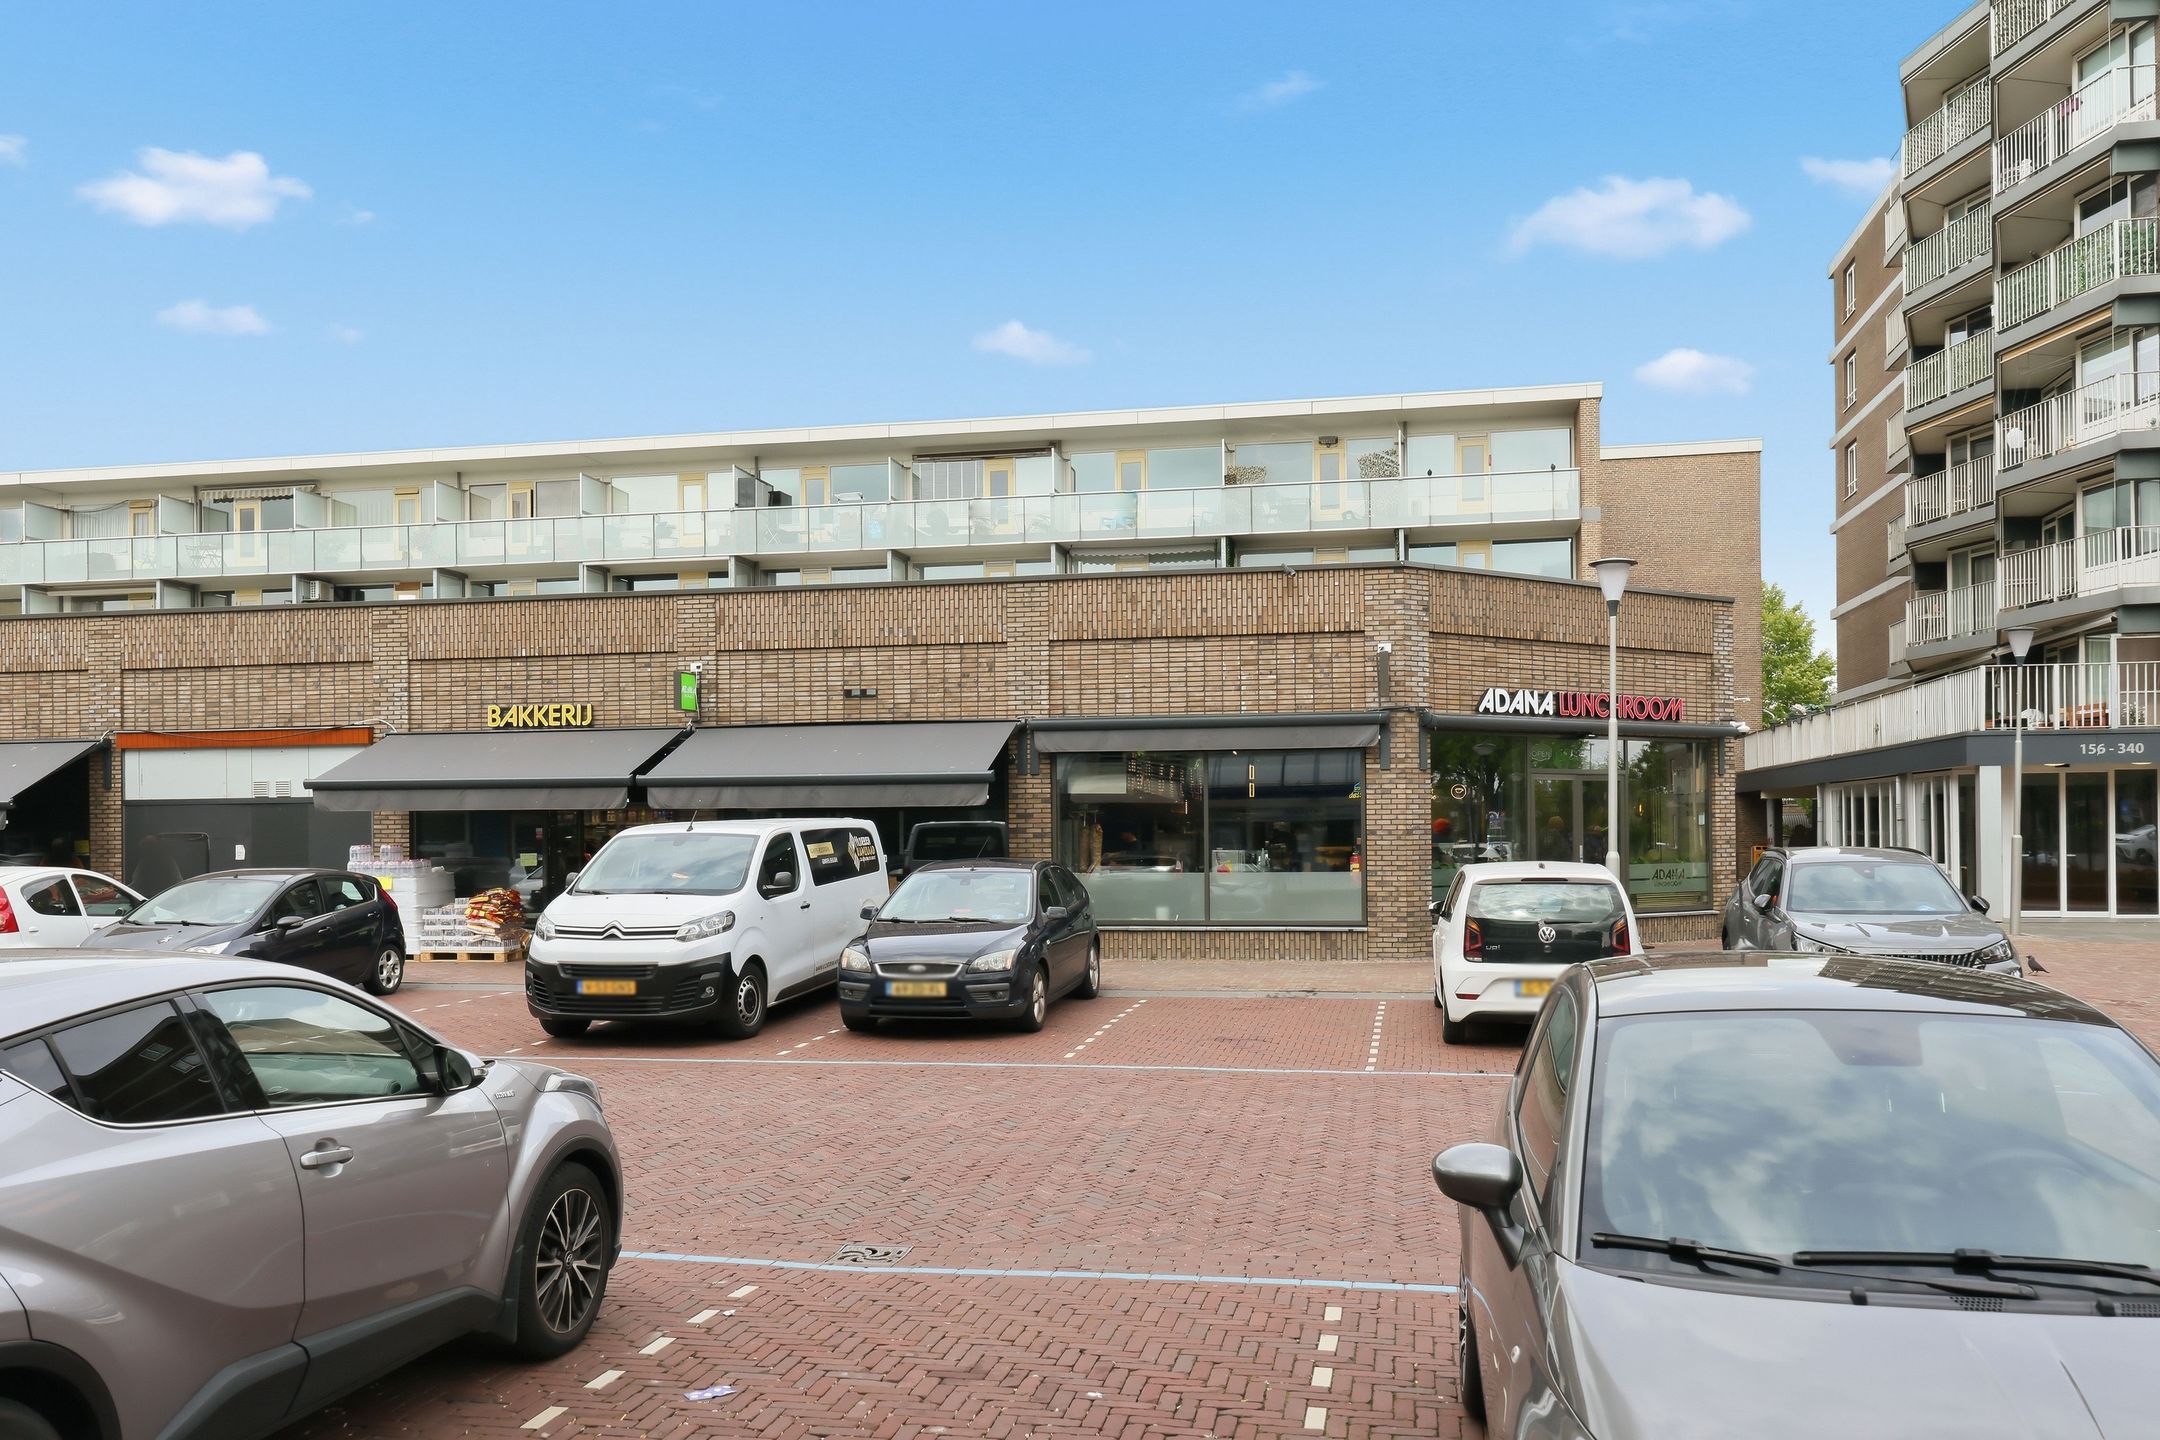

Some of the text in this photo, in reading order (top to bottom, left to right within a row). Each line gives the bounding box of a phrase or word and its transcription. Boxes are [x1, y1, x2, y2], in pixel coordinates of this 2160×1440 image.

[1478, 688, 1685, 721] ADANA LUNCHROOM
[487, 703, 592, 727] BAKKERIJ
[2080, 743, 2106, 755] 156
[2117, 742, 2145, 754] 340
[1652, 868, 1685, 880] ADANA
